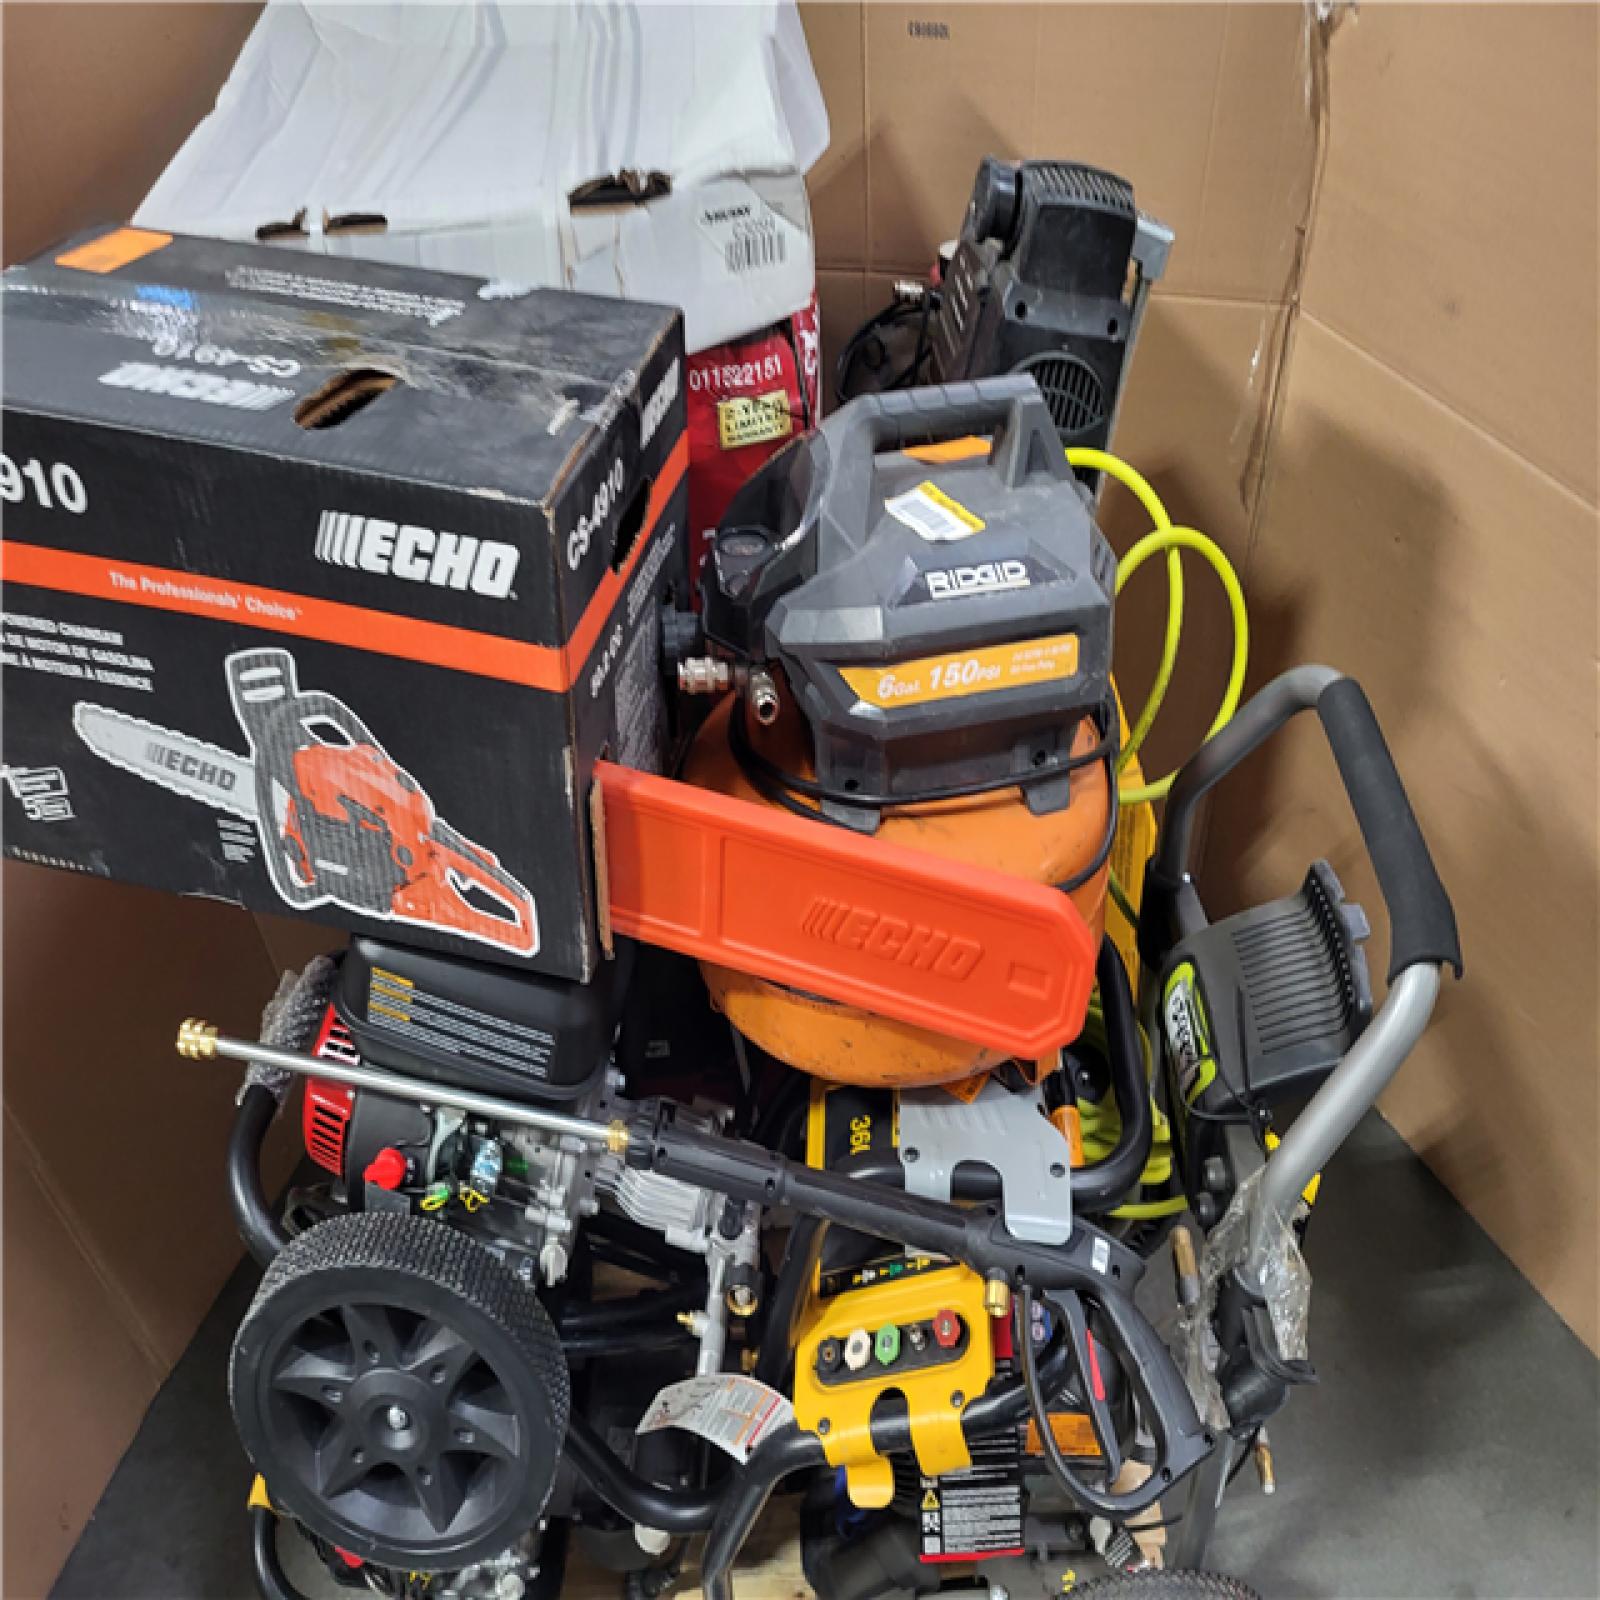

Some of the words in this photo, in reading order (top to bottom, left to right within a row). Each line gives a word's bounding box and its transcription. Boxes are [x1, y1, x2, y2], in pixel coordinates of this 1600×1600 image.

[108, 570, 138, 591] The
[358, 517, 521, 600] ECHO
[925, 559, 1030, 600] RIDGID
[163, 748, 236, 792] ECHO
[846, 904, 985, 983] ECHO
